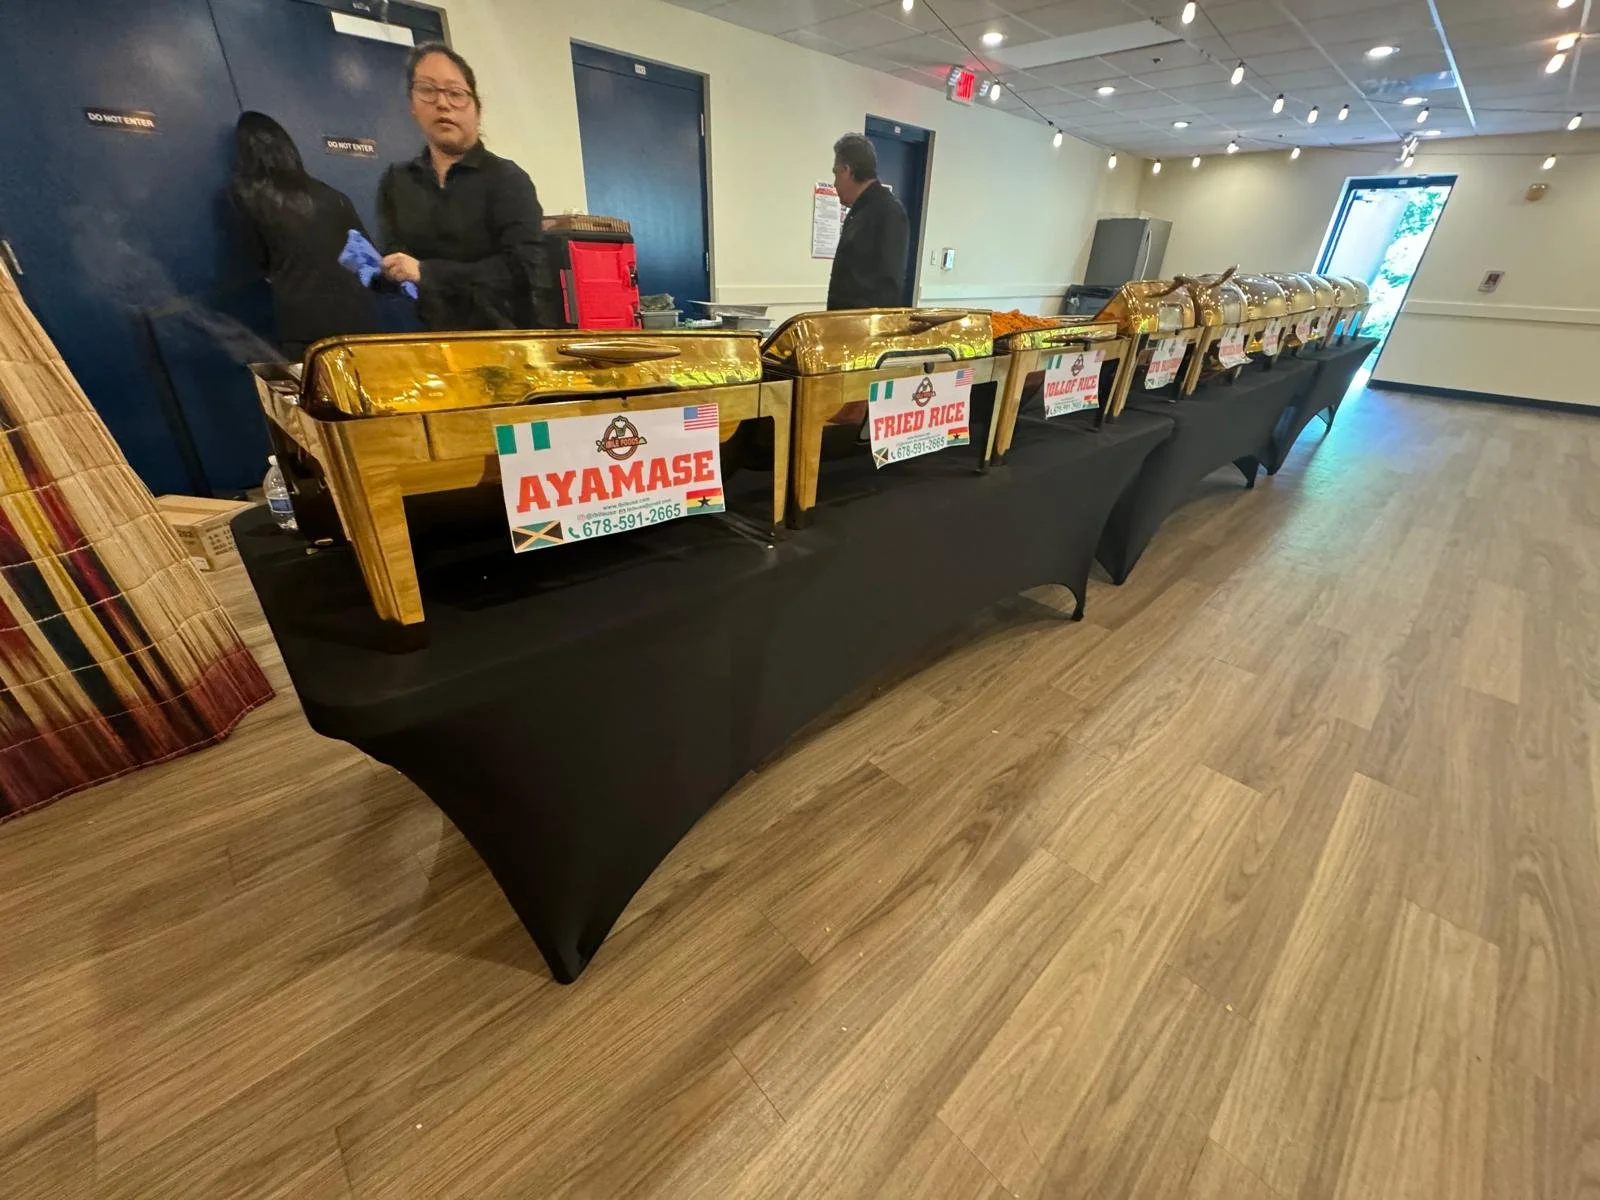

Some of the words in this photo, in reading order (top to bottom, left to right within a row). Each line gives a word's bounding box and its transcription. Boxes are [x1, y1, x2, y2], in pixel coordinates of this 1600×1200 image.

[88, 112, 103, 121] DO
[103, 114, 123, 123] NOT
[123, 117, 155, 128] ENTER
[327, 140, 338, 148] DO
[352, 143, 375, 152] ENTER
[1045, 379, 1078, 398] JOLLOF
[1077, 375, 1098, 391] RICE
[873, 409, 925, 441] FRIED
[928, 401, 965, 428] RICE
[897, 436, 945, 459] 678-591-2665
[516, 450, 715, 513] AYAMASE
[582, 503, 681, 537] 678-591-2665
